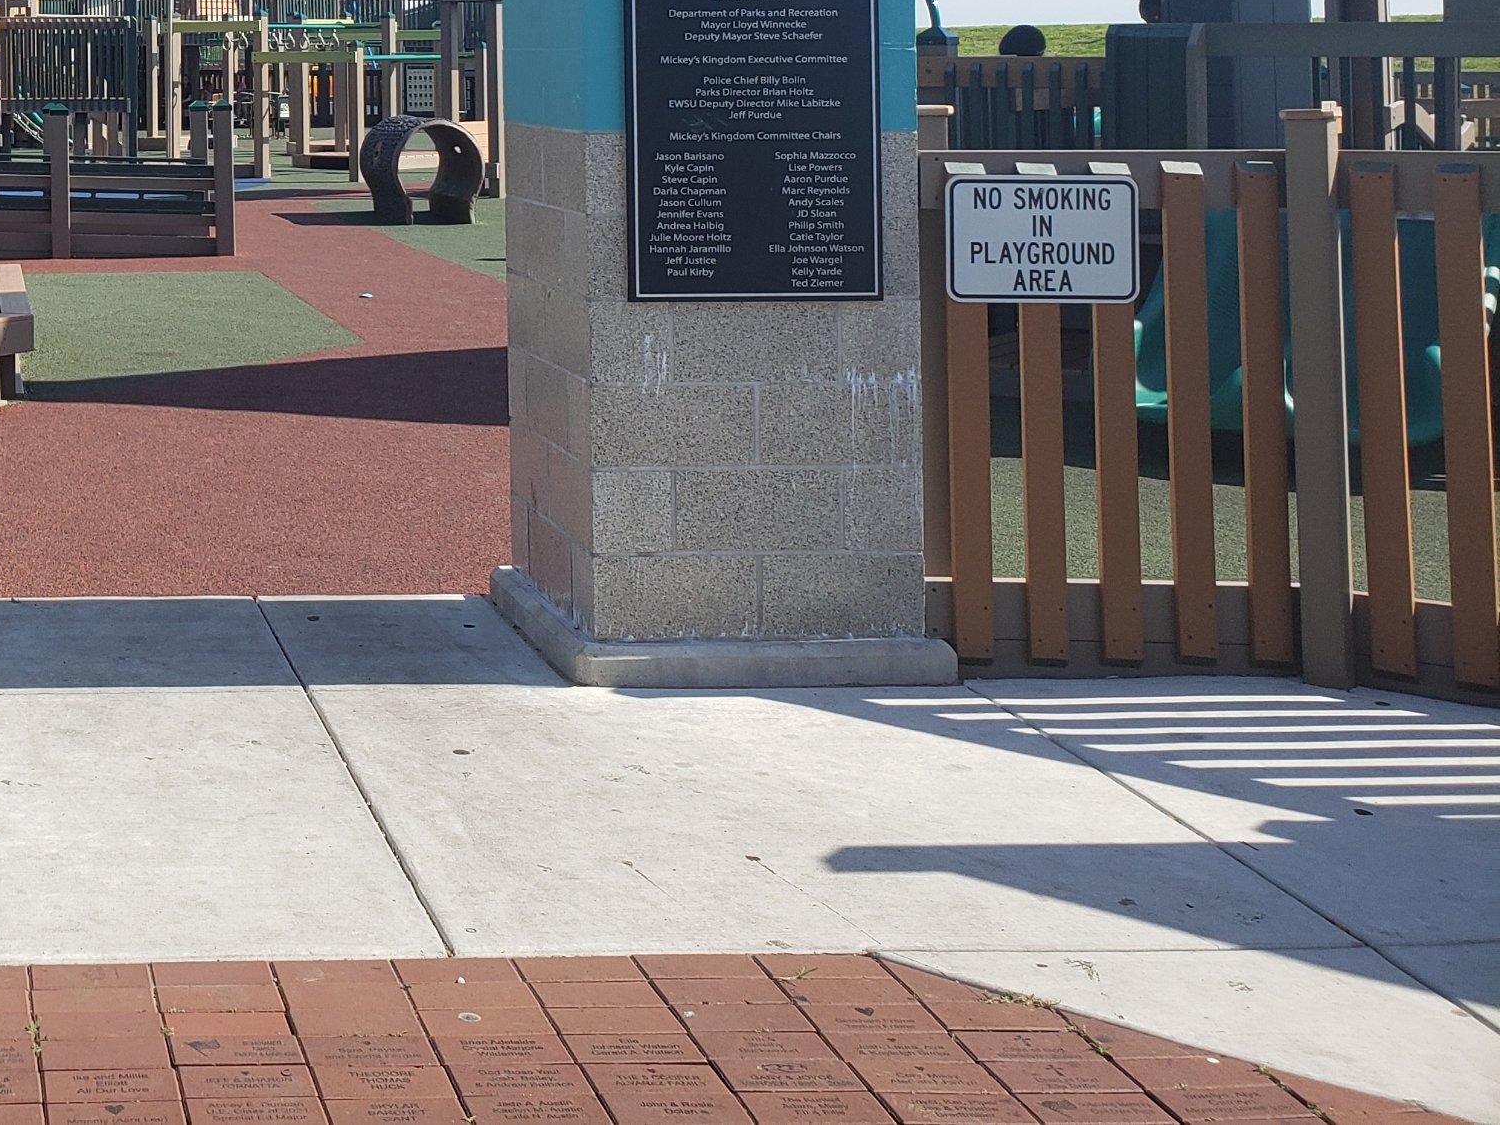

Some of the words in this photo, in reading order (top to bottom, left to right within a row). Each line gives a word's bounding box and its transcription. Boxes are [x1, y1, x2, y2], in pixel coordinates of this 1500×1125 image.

[669, 10, 727, 19] Department
[729, 9, 739, 17] of
[741, 9, 766, 17] Parks
[768, 9, 786, 17] and
[788, 9, 838, 17] Recreation
[701, 21, 731, 31] Mayor
[733, 21, 758, 31] Lloyd
[760, 20, 807, 28] Winnecke
[685, 33, 720, 42] Deputy
[722, 32, 752, 42] Mayor
[754, 32, 780, 40] Steve
[782, 31, 823, 40] Schaefer
[661, 56, 700, 66] Mickey's
[703, 55, 746, 66] Kingdom
[748, 55, 793, 63] Executive
[795, 55, 848, 63] Committee
[704, 77, 732, 85] Police
[734, 76, 759, 84] Chief
[760, 76, 780, 86] Billy
[782, 76, 806, 84] Bolin
[696, 88, 720, 96] Parks
[723, 88, 761, 96] Director
[763, 88, 787, 96] Brian
[789, 87, 814, 96] Holtz
[669, 100, 697, 108] EWSU
[699, 100, 734, 110] Deputy
[777, 99, 799, 107] Mike
[802, 99, 841, 107] Labitzke
[729, 111, 746, 119] Jeff
[748, 111, 782, 119] Purdue
[670, 132, 709, 142] Mickey's
[712, 132, 755, 142] Kingdom
[757, 132, 810, 140] Committee
[812, 131, 841, 139] Chairs
[655, 153, 682, 161] Jason
[775, 152, 807, 162] Sophia
[665, 164, 685, 174] Kyle
[687, 164, 714, 174] Capin
[809, 163, 842, 171] Powers
[662, 176, 688, 184] Steve
[690, 175, 718, 185] Capin
[784, 175, 812, 183] Aaron
[815, 175, 848, 183] Purdue
[654, 187, 678, 195] Darla
[680, 187, 726, 197] Chapman
[782, 187, 805, 195] Marc
[808, 186, 850, 196] Reynolds
[659, 199, 686, 207] Jason
[688, 198, 722, 207] Cullum
[788, 198, 813, 208] Andy
[816, 198, 844, 206] Scales
[973, 187, 1002, 210] NO
[1013, 187, 1111, 211] SMOKING
[657, 210, 695, 218] Jennifer
[697, 210, 724, 218] Evans
[796, 210, 809, 218] JD
[811, 209, 837, 218] Sloan
[657, 221, 691, 230] Andrea
[694, 221, 724, 232] Halbig
[789, 221, 815, 231] Philip
[817, 221, 844, 229] Smith
[1032, 215, 1053, 237] IN
[649, 233, 671, 241] Julie
[674, 233, 705, 241] Moore
[707, 233, 732, 241] Holtz
[790, 233, 814, 241] Catie
[815, 233, 844, 243] Taylor
[650, 245, 686, 253] Hannah
[689, 245, 731, 253] Jaramillo
[769, 244, 786, 253] Ella
[788, 244, 827, 253] Johnson
[829, 244, 864, 252] Watson
[970, 241, 1115, 265] PLAYGROUND
[665, 256, 683, 265] Jeff
[684, 257, 717, 265] Justice
[792, 256, 808, 264] Joe
[810, 255, 843, 266] Wargel
[668, 268, 687, 276] Paul
[690, 268, 714, 278] Kirby
[792, 267, 814, 277] Kelly
[816, 267, 842, 275] Yarde
[791, 279, 808, 287] Ted
[810, 279, 844, 287] Ziemer
[1013, 269, 1073, 292] AREA
[72, 1073, 90, 1081] Ike
